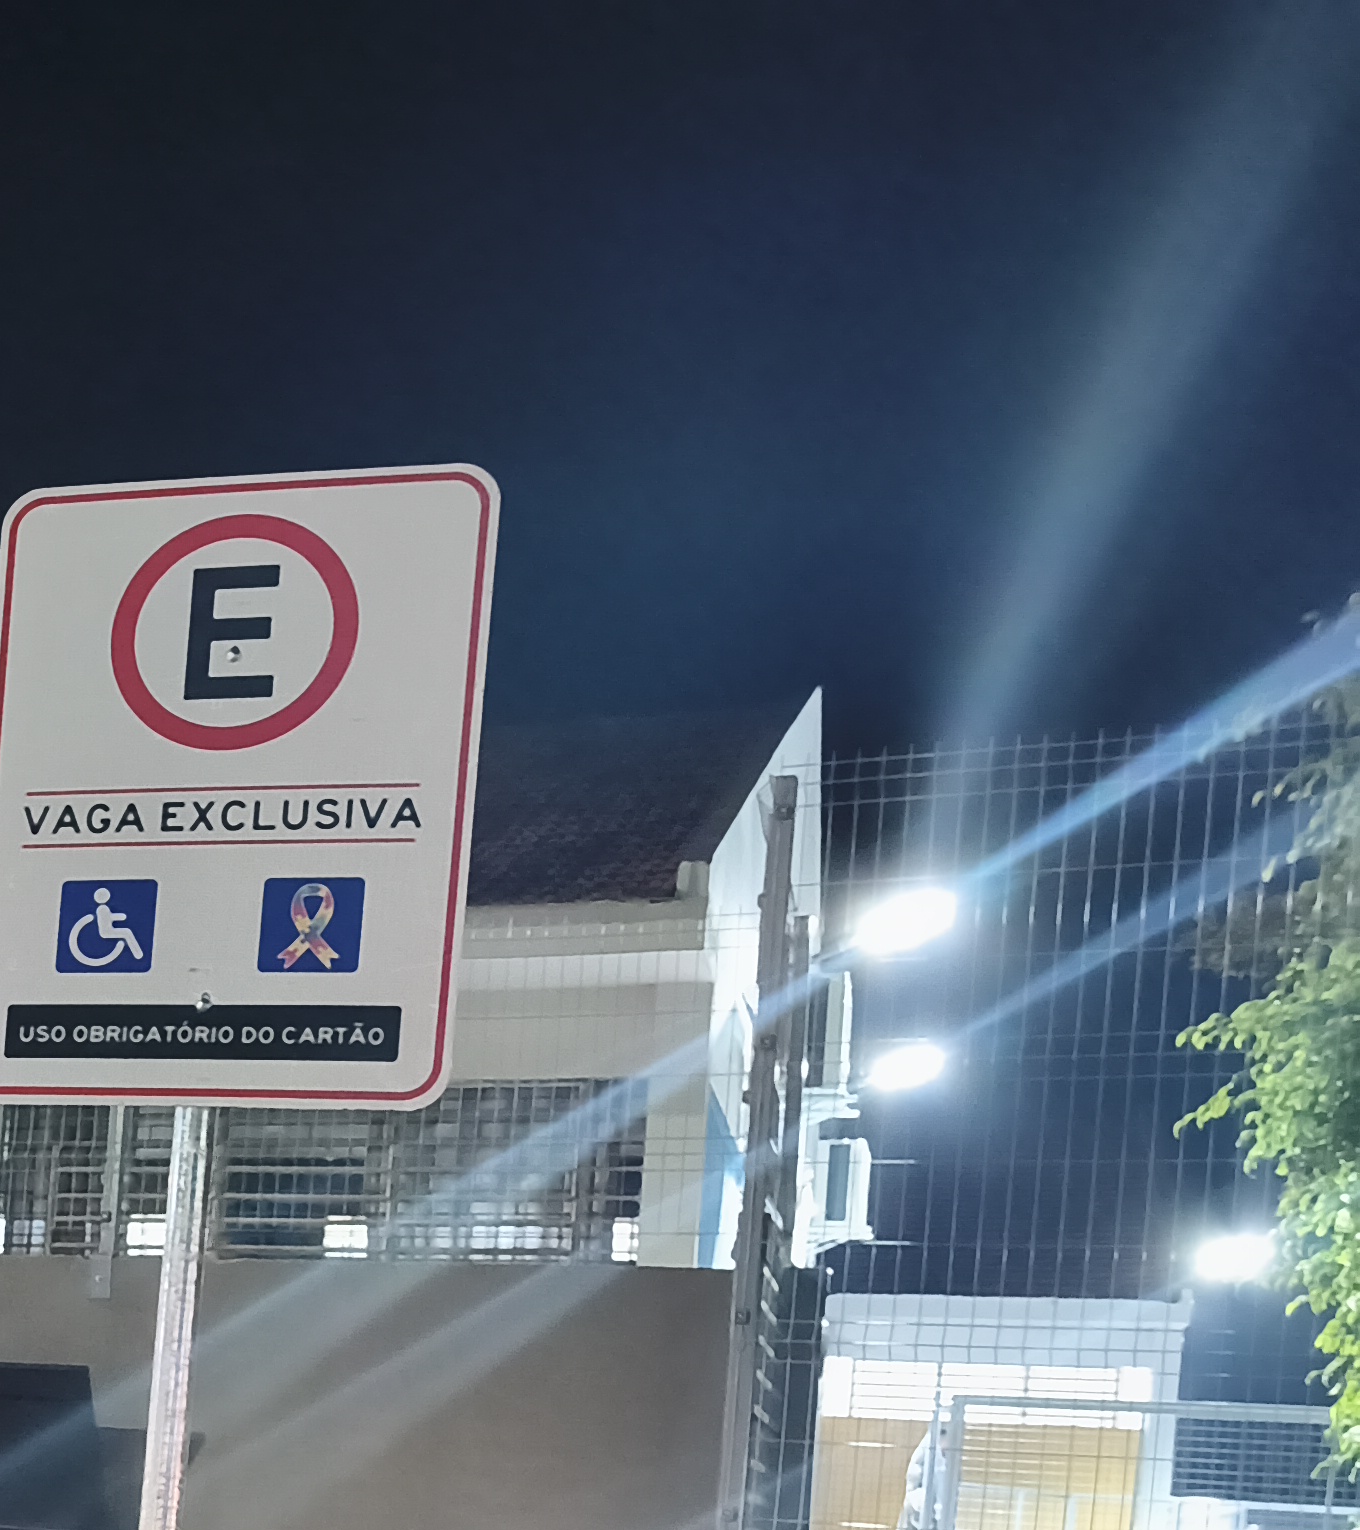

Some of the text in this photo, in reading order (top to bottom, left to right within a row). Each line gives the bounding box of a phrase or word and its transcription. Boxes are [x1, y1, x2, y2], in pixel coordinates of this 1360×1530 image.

[184, 565, 280, 700] E
[23, 798, 423, 835] VAGA EXCLUSIVA
[18, 1021, 385, 1046] USO OBRIGATÓRIO DO CARTÃO
